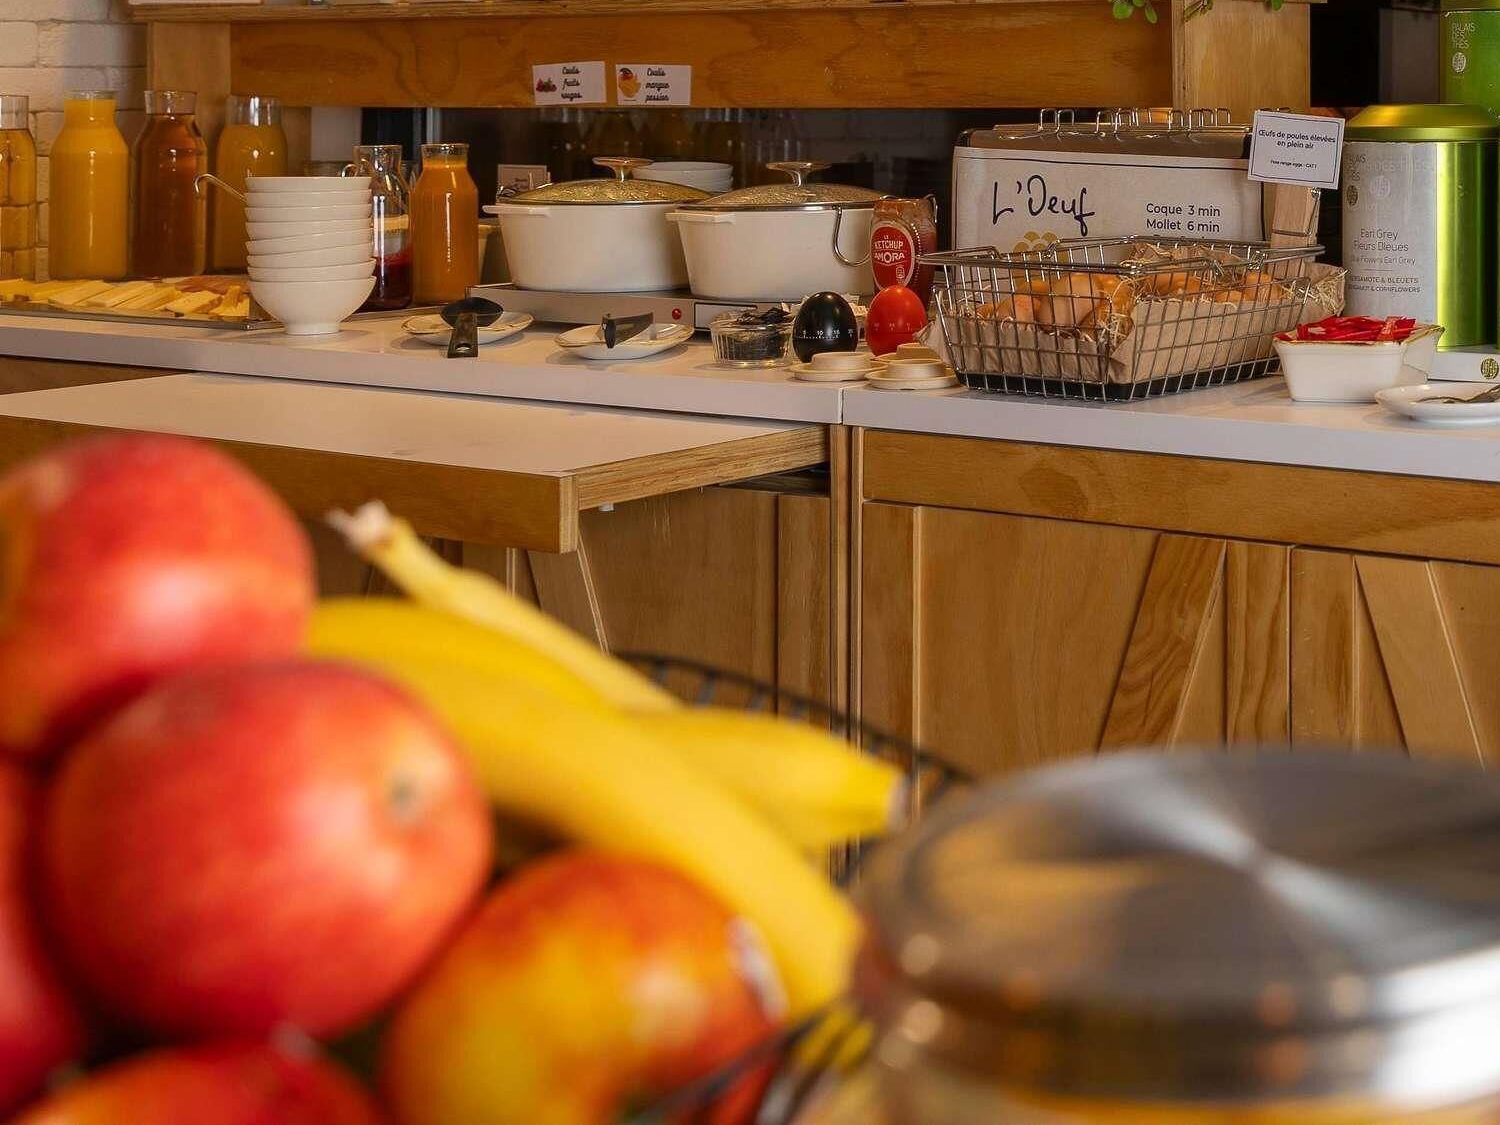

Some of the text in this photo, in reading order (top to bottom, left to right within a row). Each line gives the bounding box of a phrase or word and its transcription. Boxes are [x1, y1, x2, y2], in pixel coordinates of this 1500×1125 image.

[1258, 129, 1276, 138] Œufs
[1277, 131, 1286, 139] de
[1286, 132, 1309, 141] poules
[1286, 140, 1304, 148] plein
[1304, 141, 1314, 149] air
[1146, 203, 1221, 218] Coque 3 min
[1146, 218, 1220, 233] Mollet 6 min
[1360, 228, 1400, 241] Earl Grey
[874, 240, 904, 249] KETCHUP
[874, 252, 905, 264] AMORA
